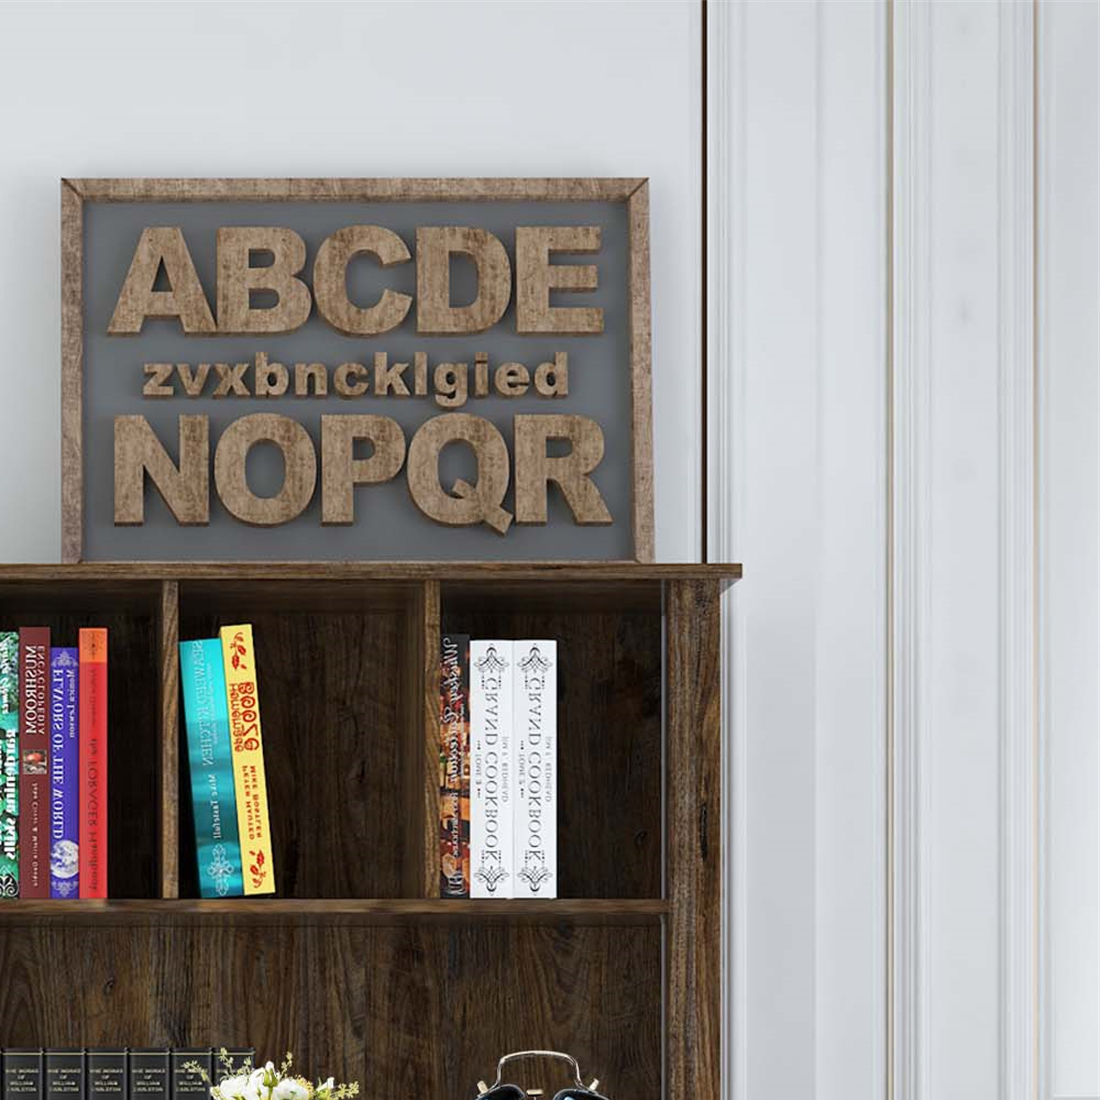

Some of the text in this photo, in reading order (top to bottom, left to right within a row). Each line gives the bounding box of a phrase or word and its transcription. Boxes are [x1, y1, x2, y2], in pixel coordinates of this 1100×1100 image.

[107, 224, 604, 336] ABCDE
[142, 351, 569, 410] zvxbncklgied
[113, 412, 614, 537] NOPQR
